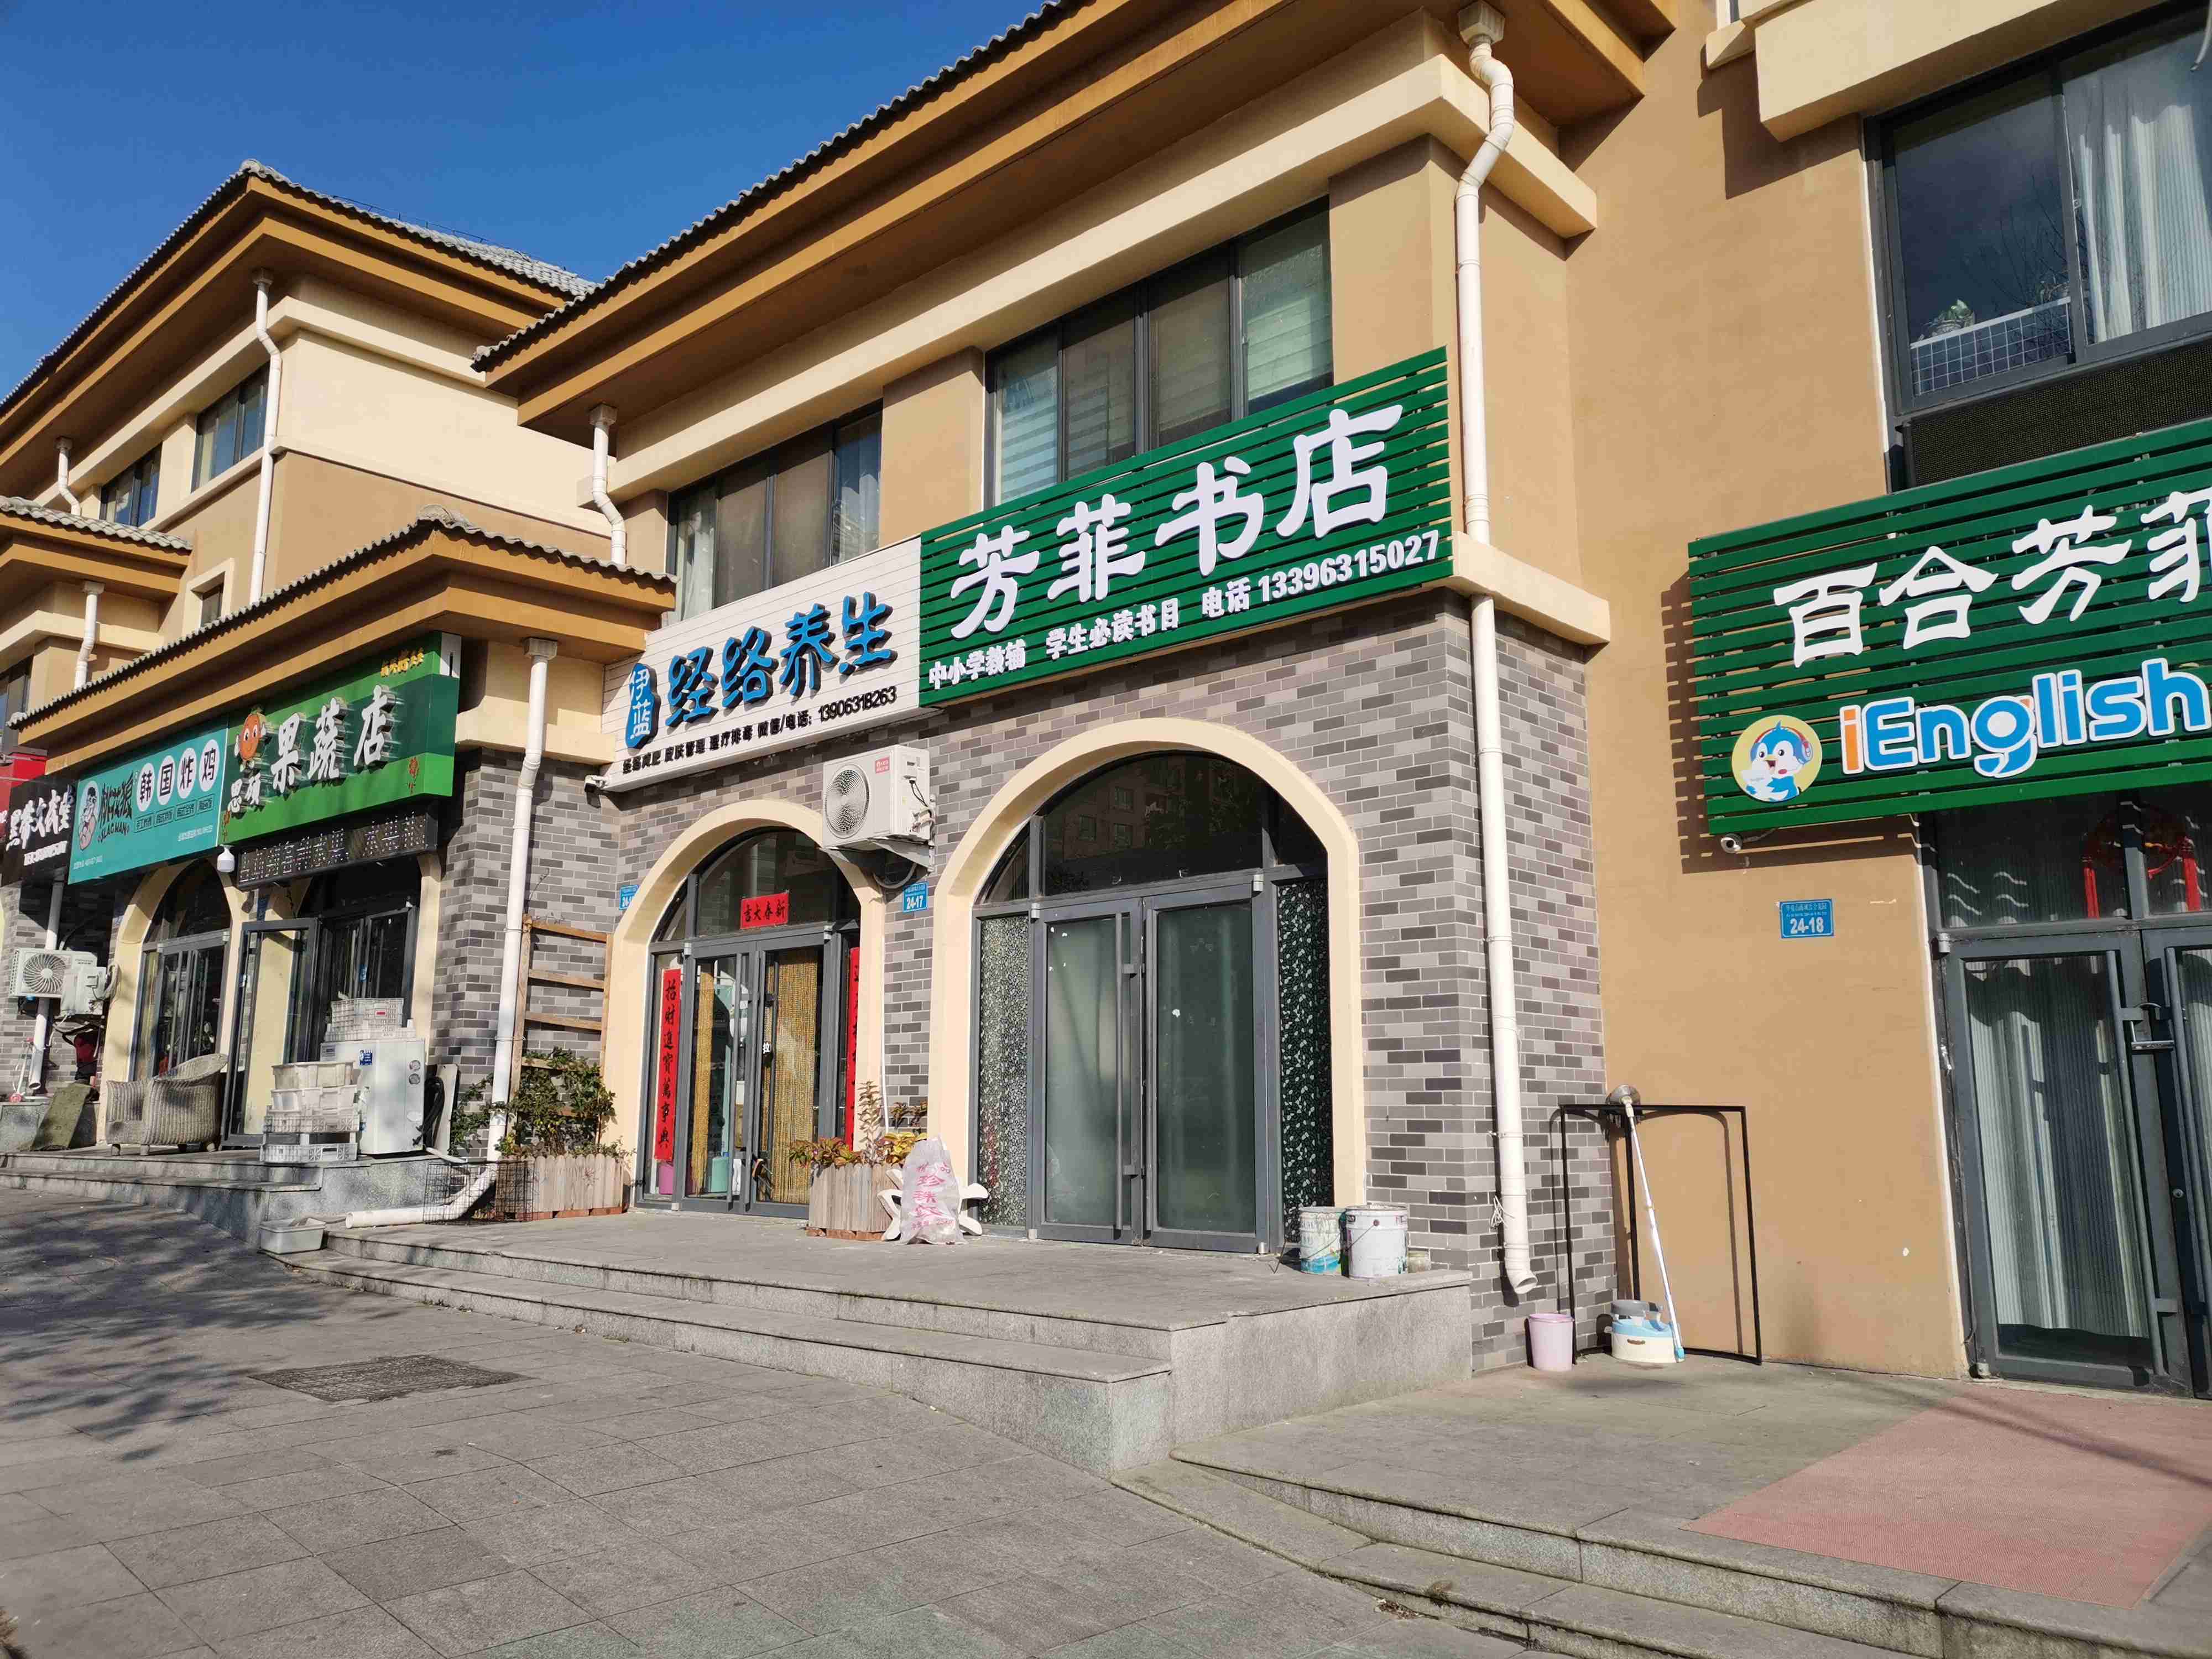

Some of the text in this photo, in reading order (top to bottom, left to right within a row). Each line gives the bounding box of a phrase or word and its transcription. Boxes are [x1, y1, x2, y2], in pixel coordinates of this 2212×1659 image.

[951, 405, 1403, 639] 芳菲书店
[1202, 530, 1439, 618] 电话 13396315027
[665, 592, 895, 728] 经络养生
[929, 639, 1026, 689] 中小学教辅
[1046, 598, 1180, 660] 学生必读书目
[628, 669, 651, 739] 伊蓝
[818, 685, 897, 722] 13906318263
[1840, 658, 2211, 778] iEnglish
[271, 685, 388, 793] 果蔬店
[140, 747, 216, 803] 韩国炸鸡
[1790, 917, 1824, 934] 24-18
